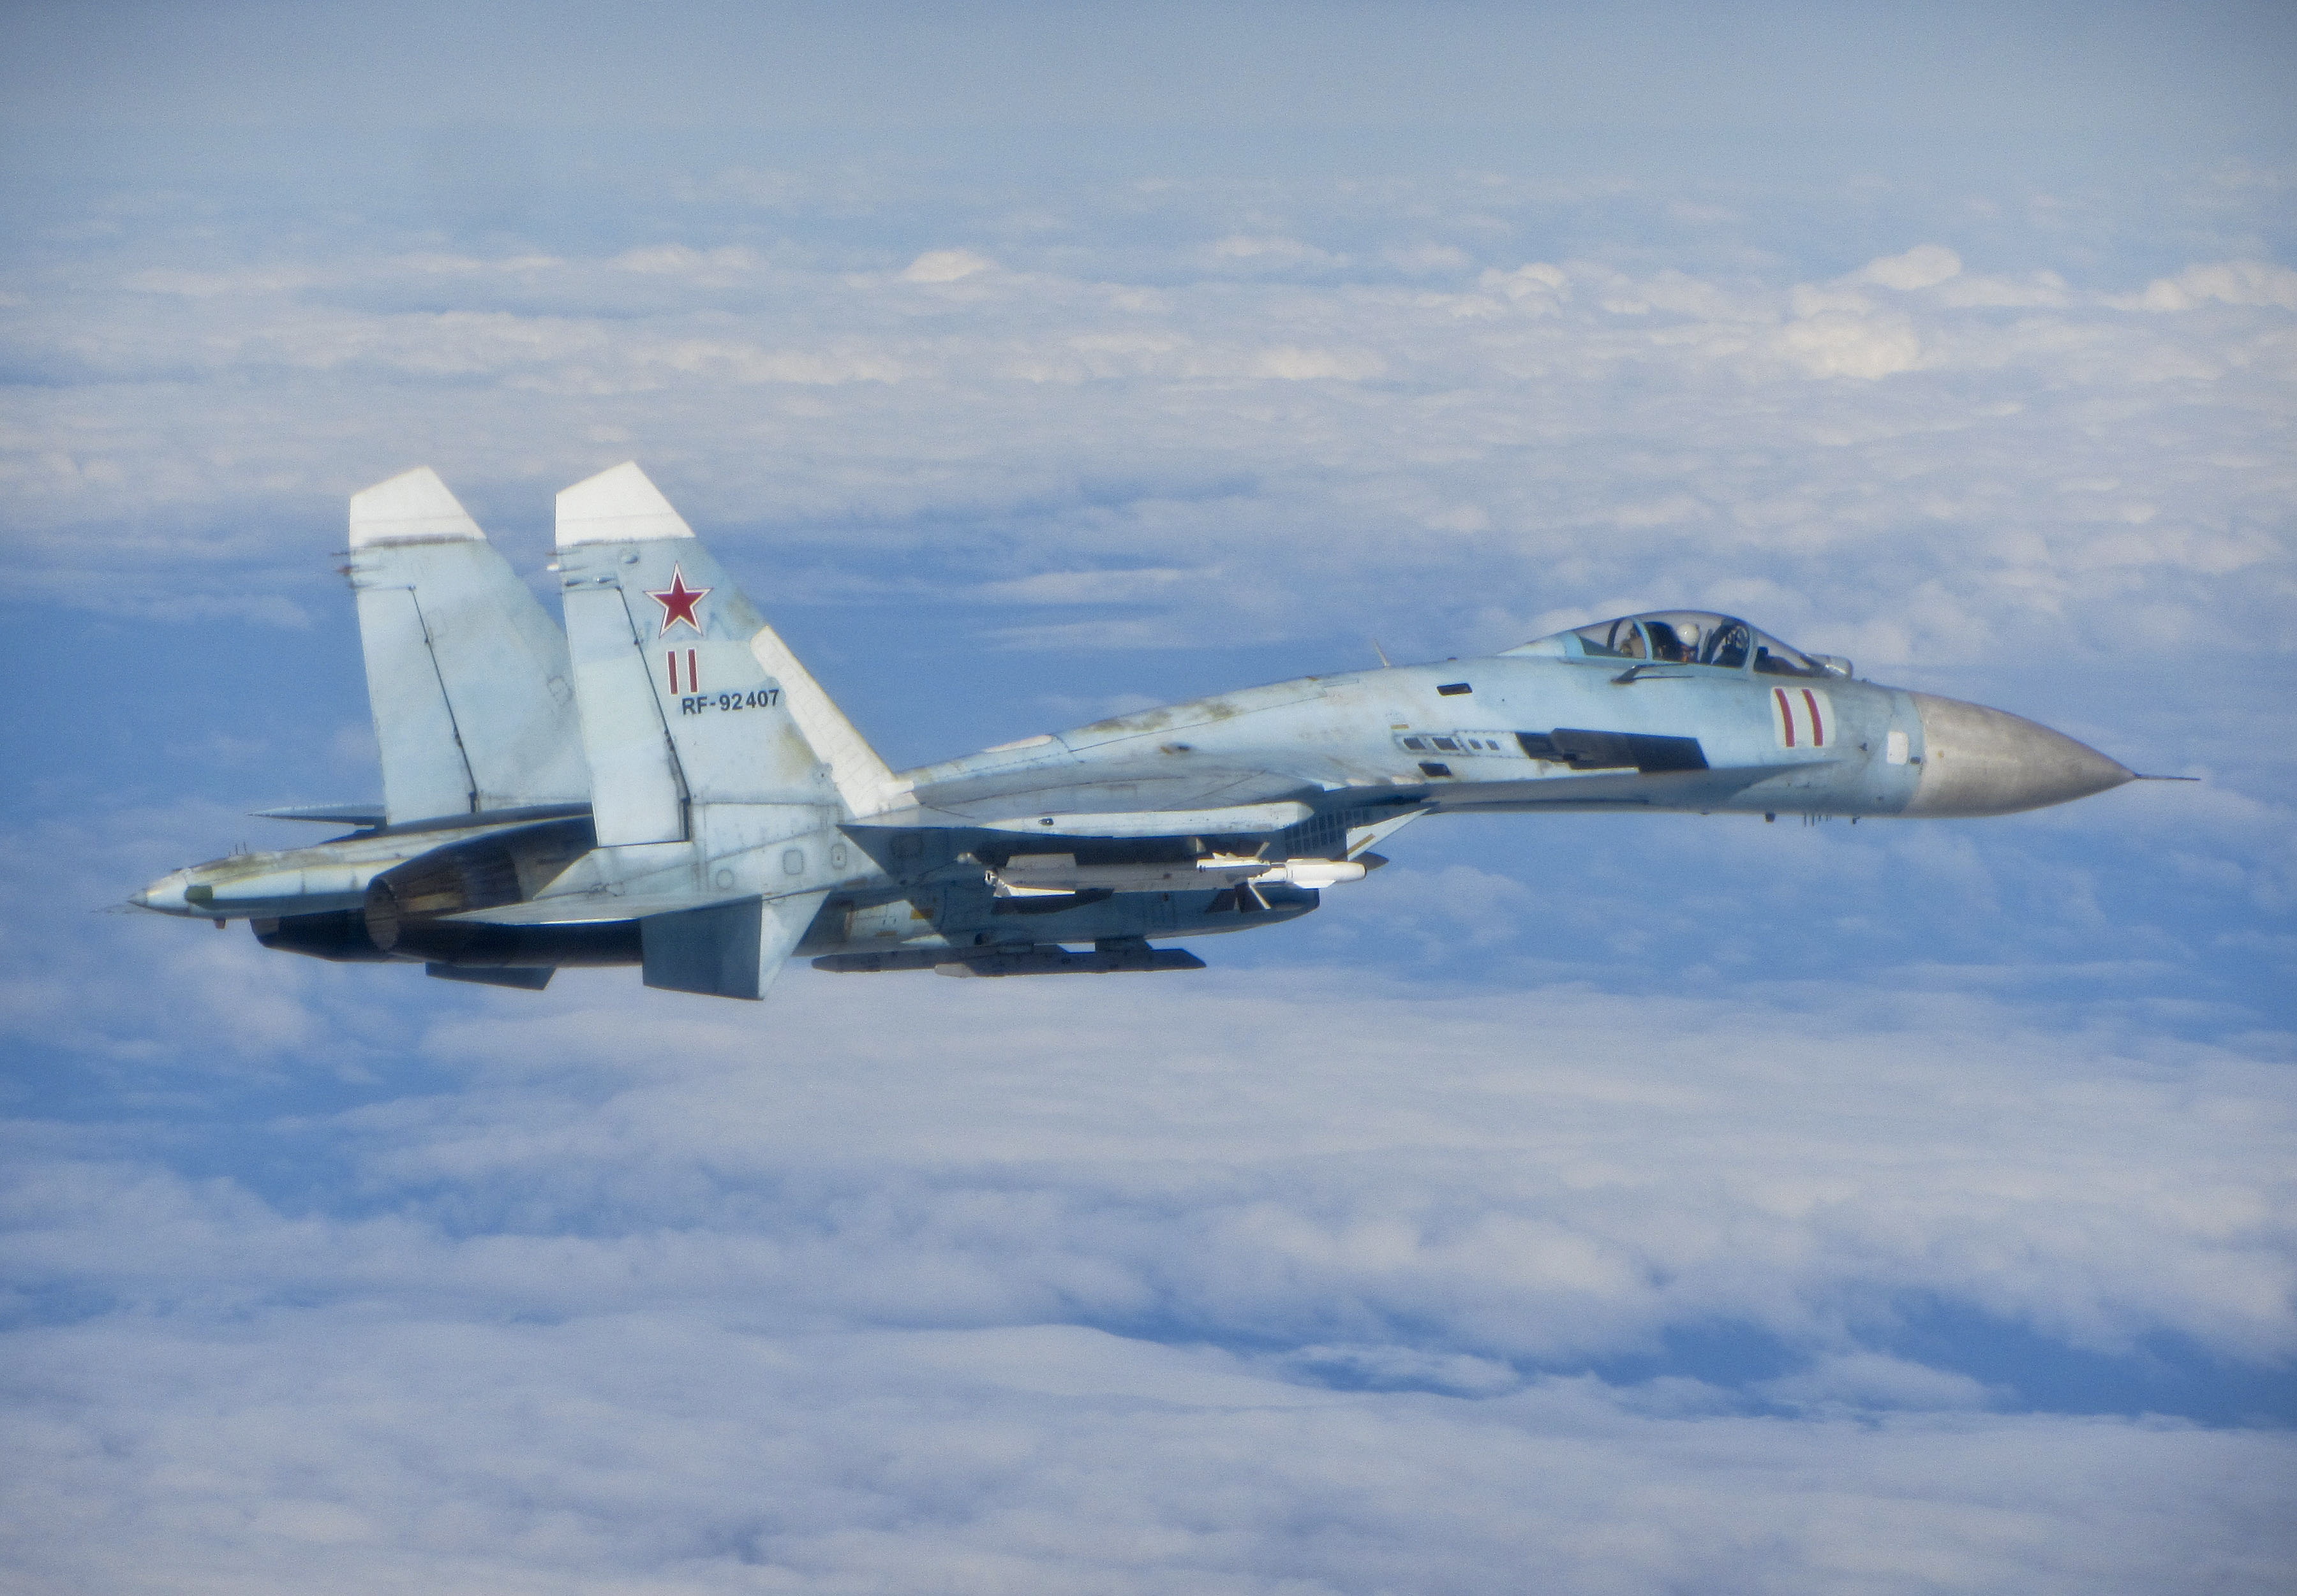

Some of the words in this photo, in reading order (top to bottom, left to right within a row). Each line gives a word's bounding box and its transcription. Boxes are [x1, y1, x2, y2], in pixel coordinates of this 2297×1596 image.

[667, 648, 699, 695] 11
[681, 688, 779, 715] RF-92407
[1773, 688, 1824, 748] 11
